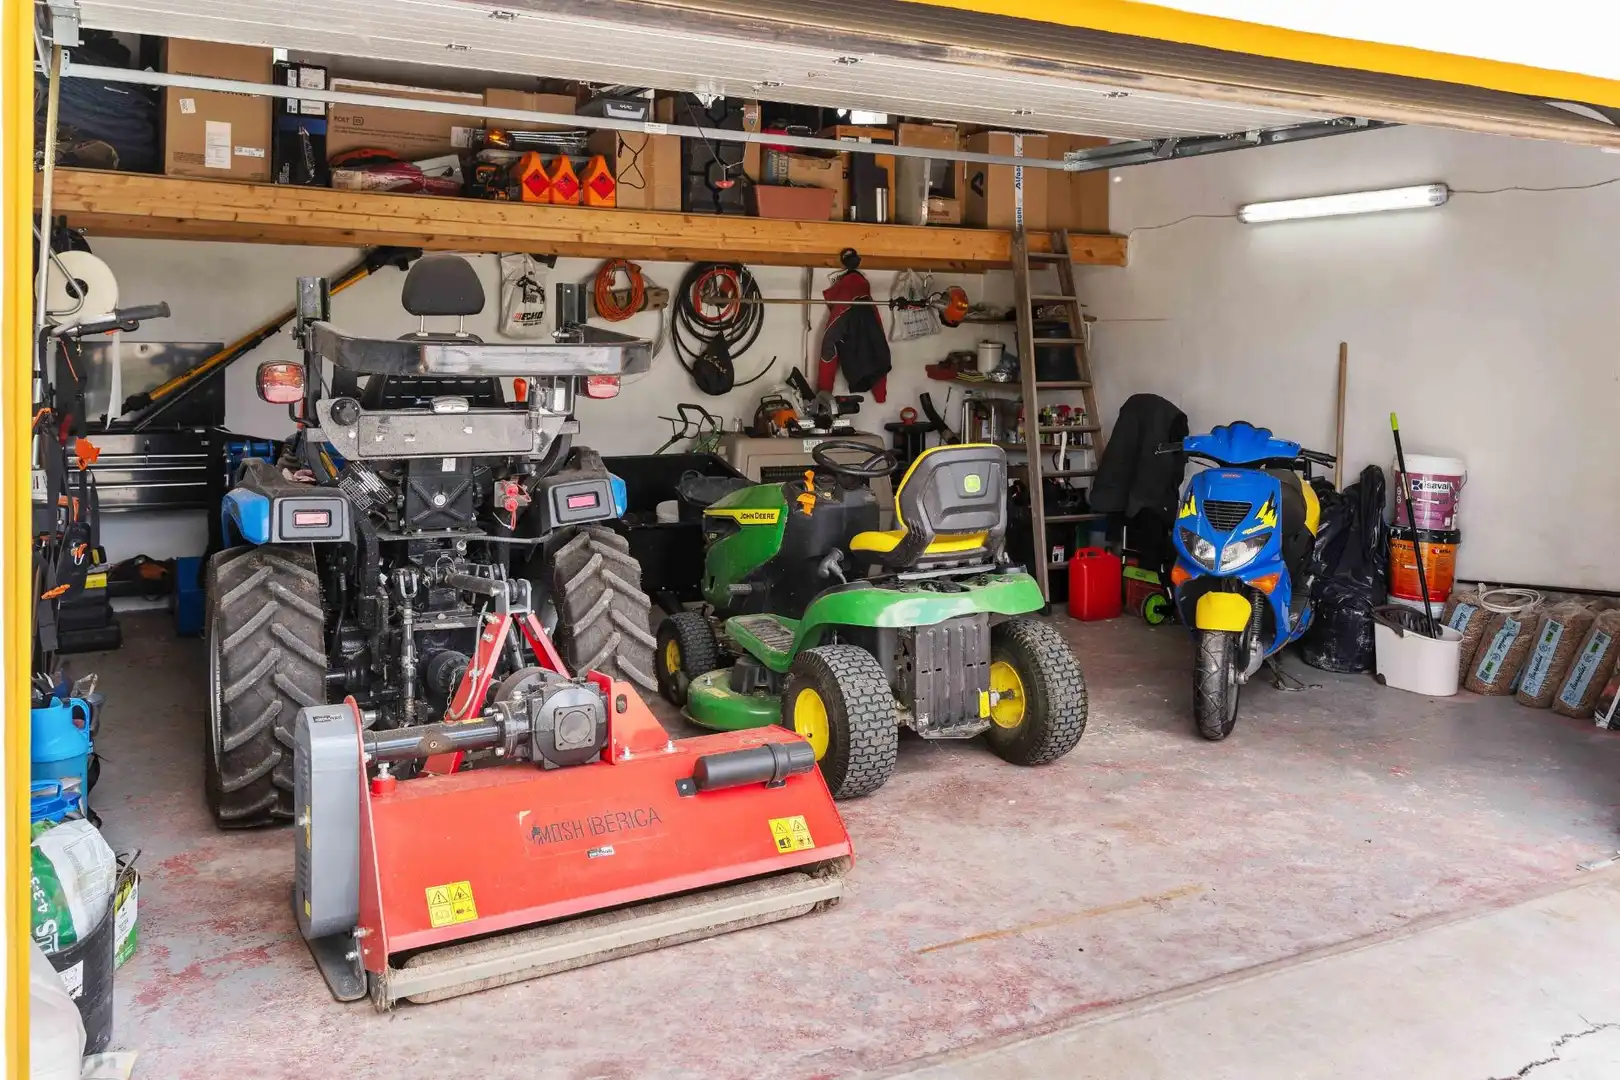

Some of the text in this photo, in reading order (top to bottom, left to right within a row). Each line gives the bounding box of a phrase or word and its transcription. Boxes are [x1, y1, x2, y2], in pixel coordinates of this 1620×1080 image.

[1015, 165, 1023, 190] Alfas
[521, 311, 543, 320] ECHO
[740, 512, 775, 520] JOHN DEERE
[540, 819, 585, 844] MOSH
[36, 920, 58, 953] LUS
